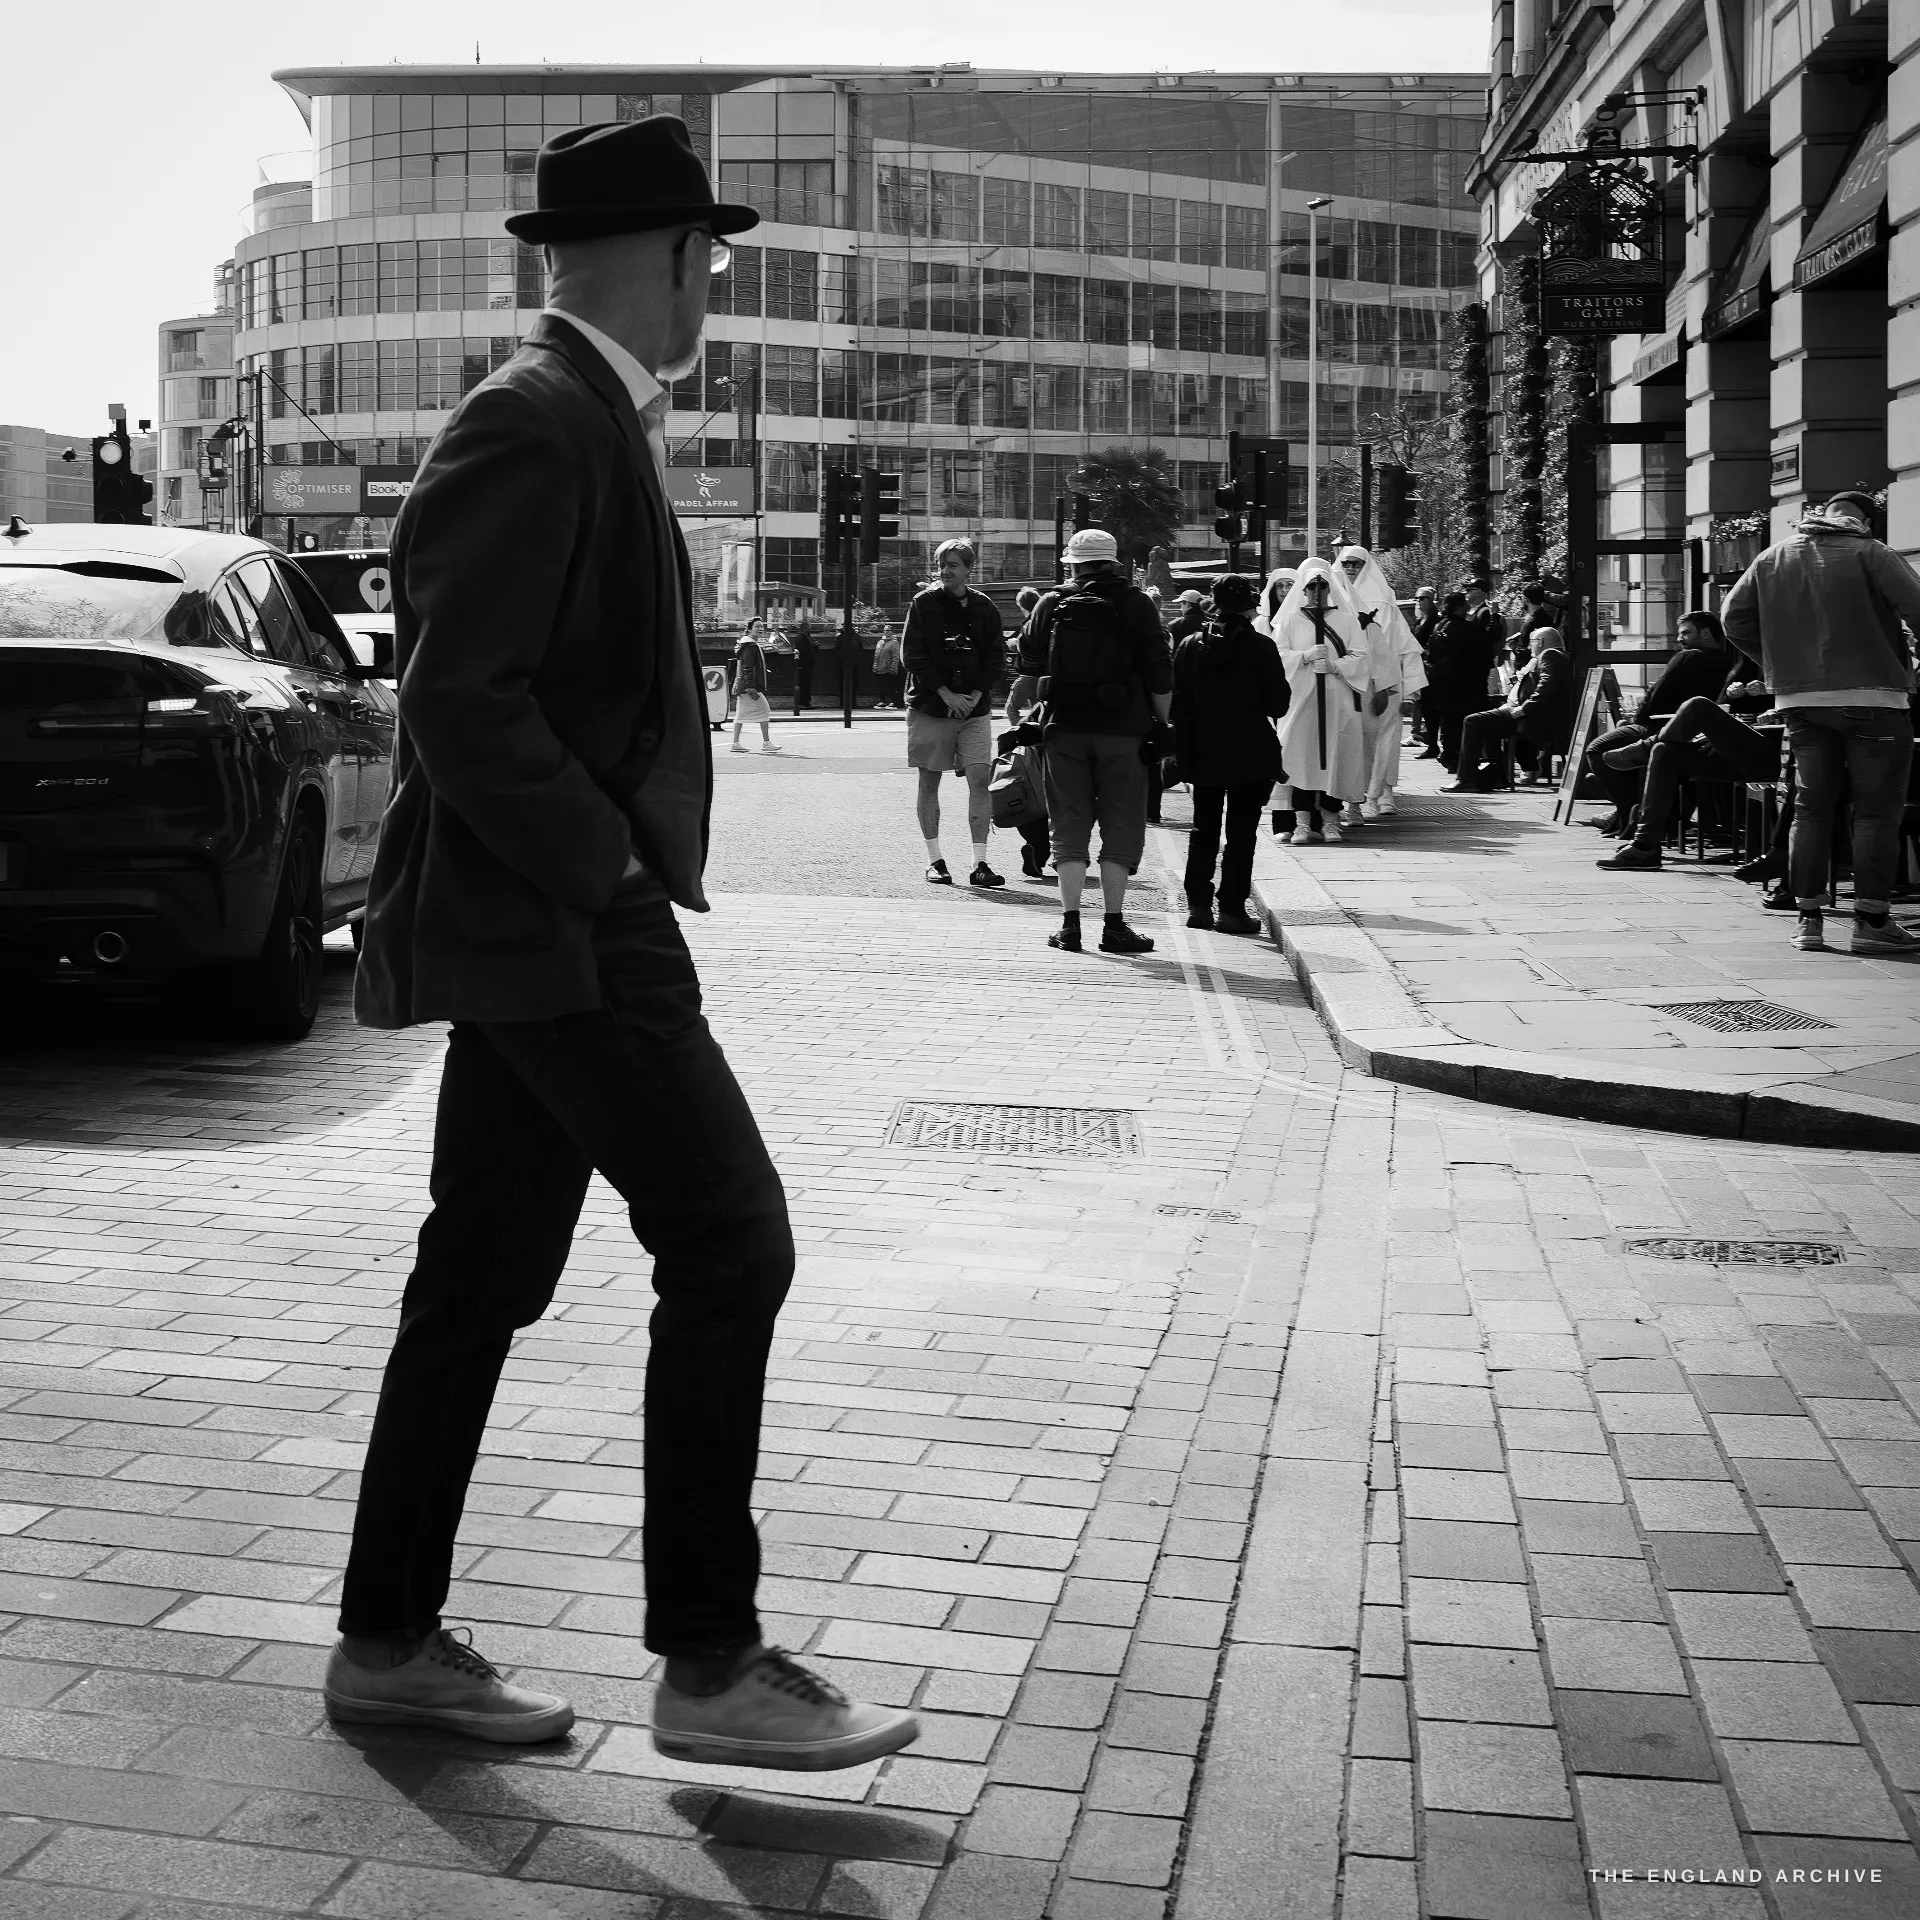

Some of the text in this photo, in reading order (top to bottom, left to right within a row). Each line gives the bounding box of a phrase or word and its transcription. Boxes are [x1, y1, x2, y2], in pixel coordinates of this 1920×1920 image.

[1562, 296, 1644, 308] TRAITORS
[1581, 308, 1625, 318] GATE
[287, 484, 352, 494] OPTIMISER
[369, 484, 398, 494] Book
